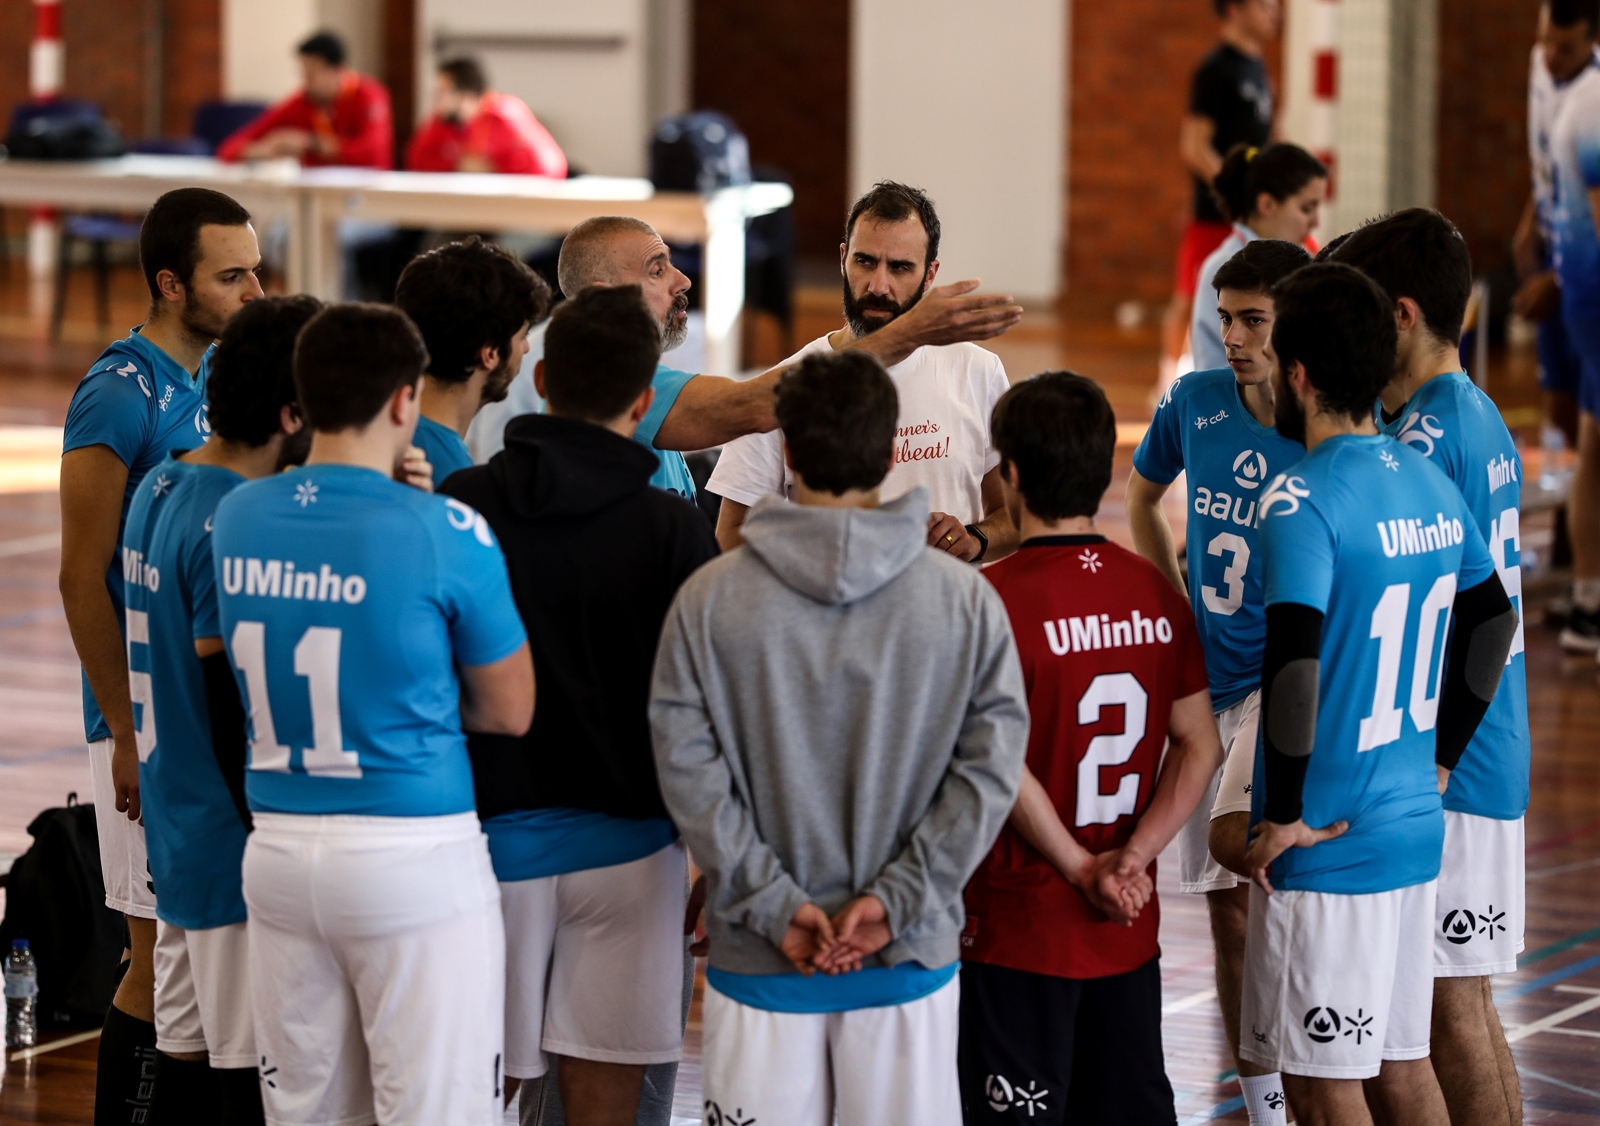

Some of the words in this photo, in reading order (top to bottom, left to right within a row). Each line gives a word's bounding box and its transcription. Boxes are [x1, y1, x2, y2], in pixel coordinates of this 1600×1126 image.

[1210, 409, 1229, 424] cdt
[1194, 486, 1259, 529] aau
[1377, 512, 1464, 558] UMinho
[223, 556, 367, 604] UMinho
[1201, 531, 1251, 616] 3
[1043, 609, 1173, 656] UMinho
[1357, 572, 1457, 753] 10
[230, 619, 363, 779] 11
[1075, 670, 1148, 827] 2
